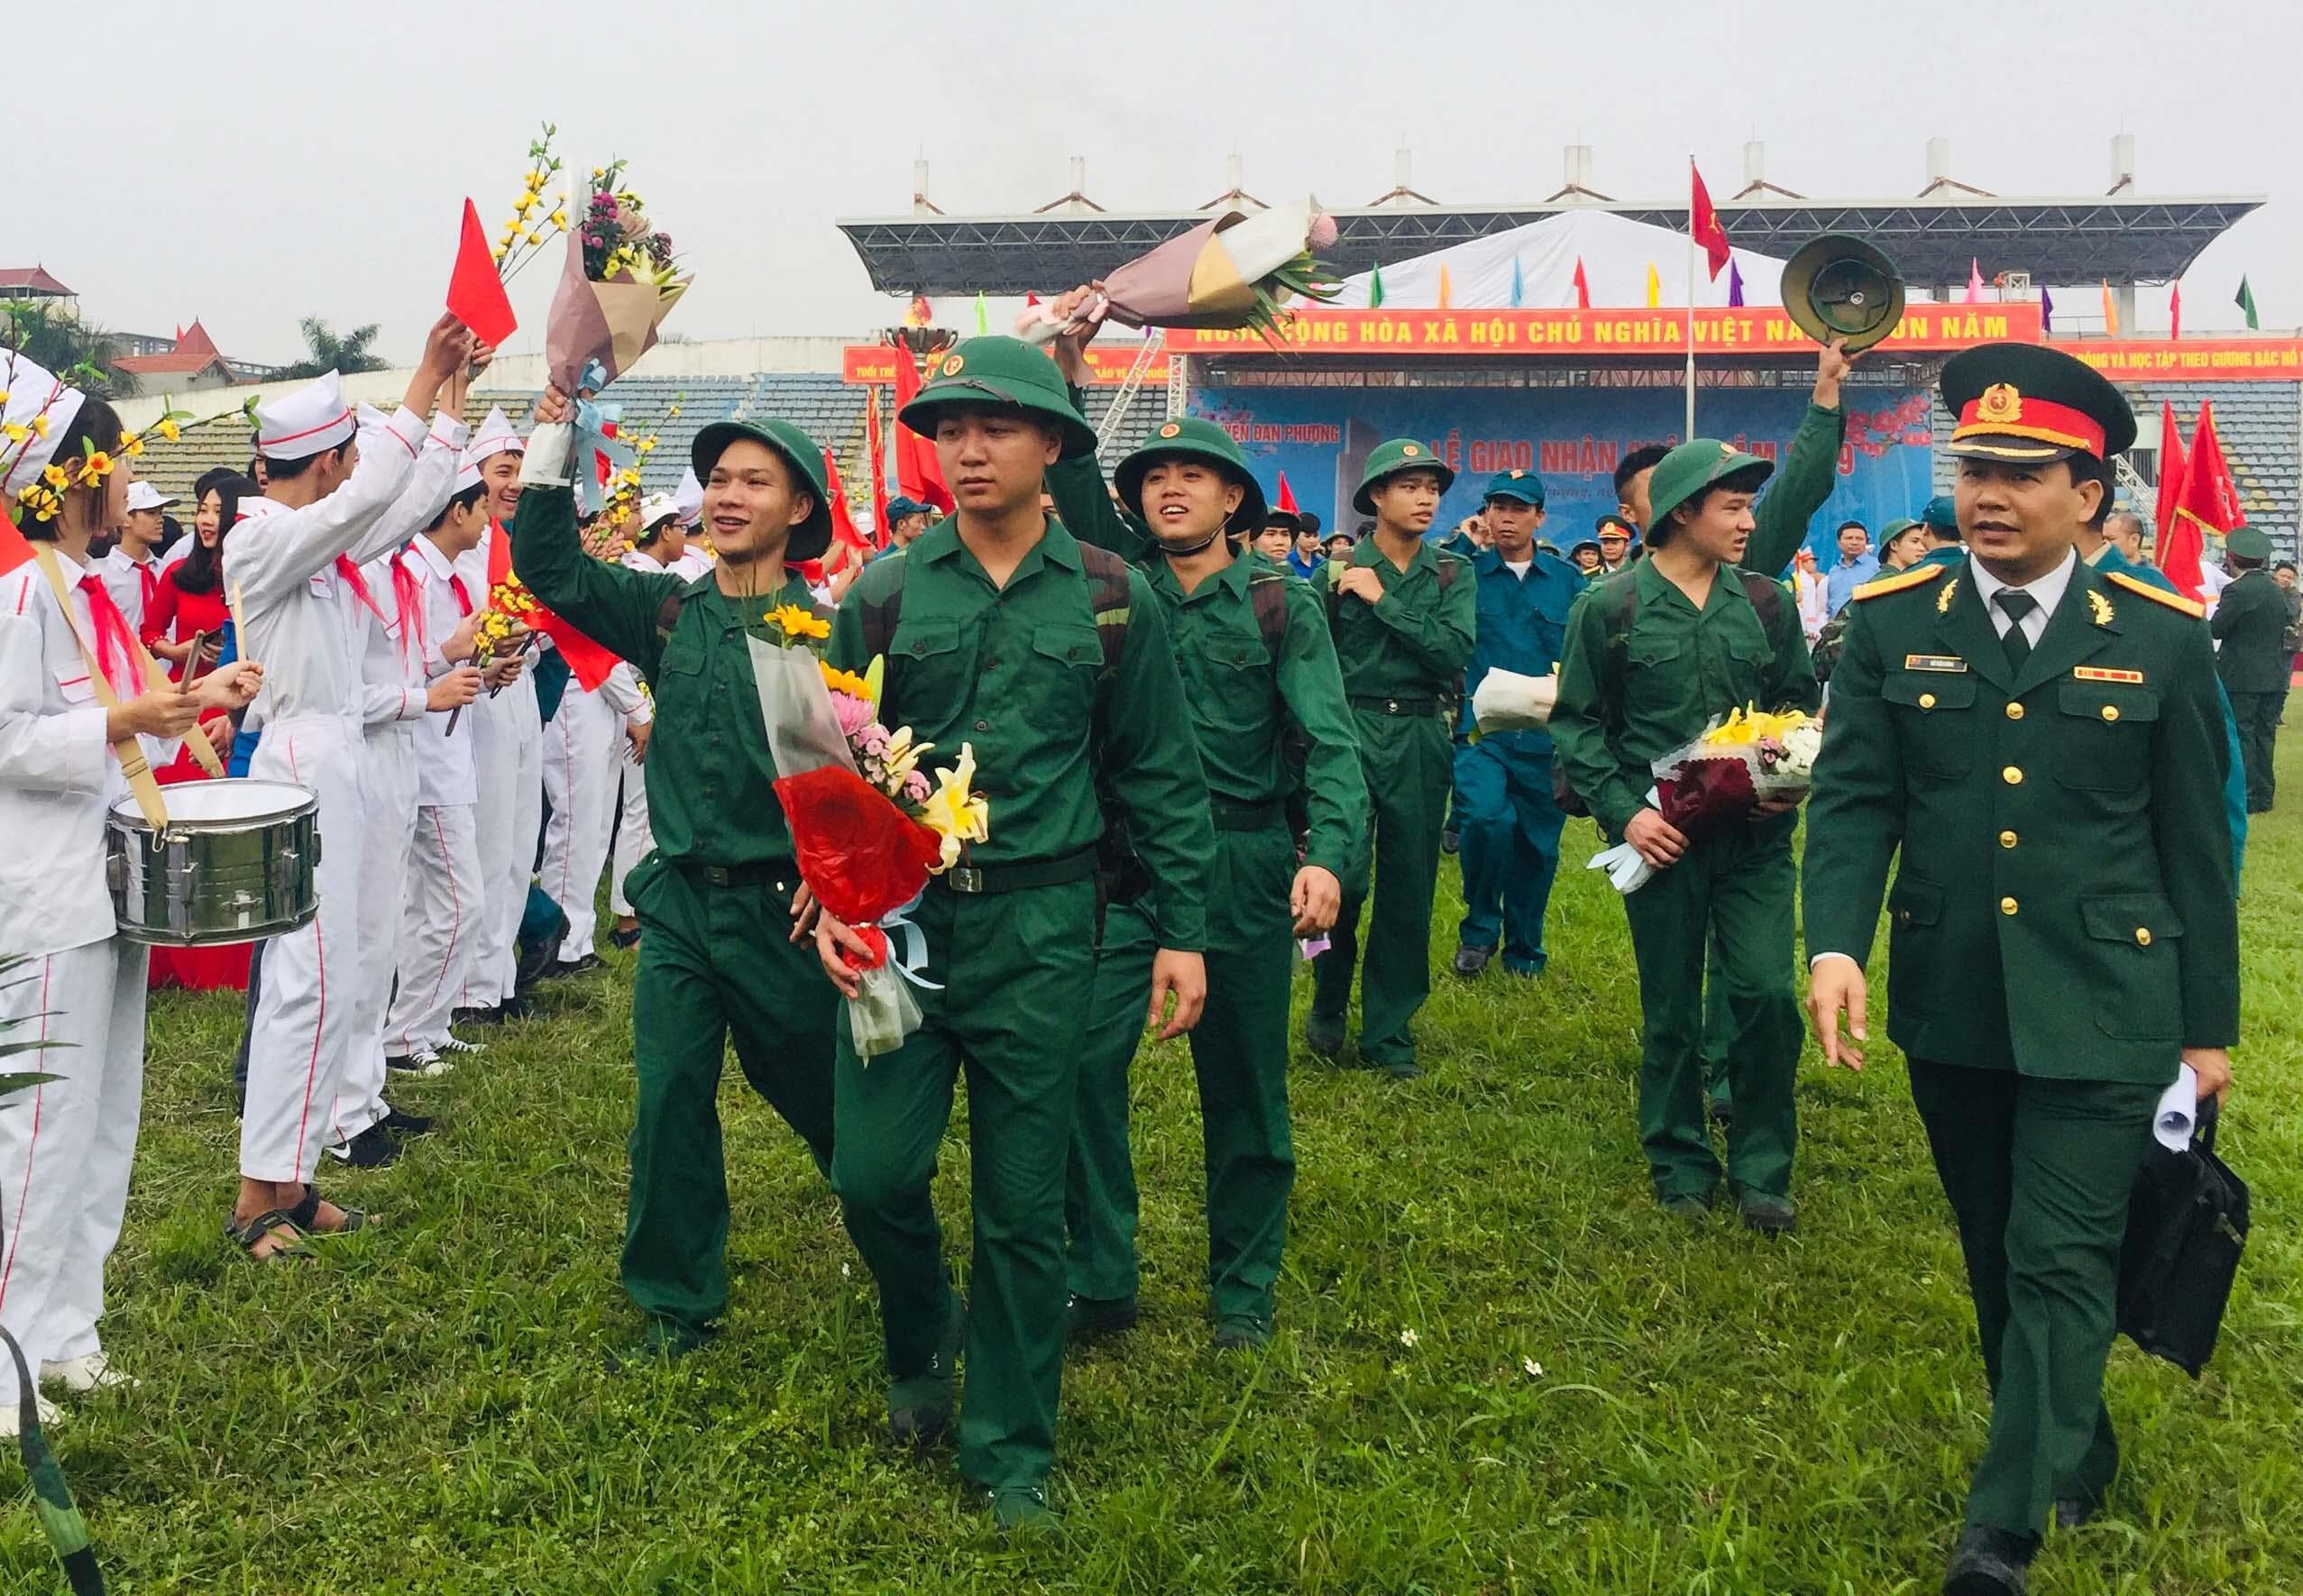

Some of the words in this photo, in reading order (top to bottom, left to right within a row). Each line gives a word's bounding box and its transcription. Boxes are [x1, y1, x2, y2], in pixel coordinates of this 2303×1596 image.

[1360, 316, 1413, 343] HÒA
[1424, 317, 1458, 344] XÃ
[1470, 317, 1516, 347] HỘI
[1528, 314, 1582, 344] CHỦ
[1593, 316, 1681, 344] NGHĨA
[1693, 316, 1754, 346] VIỆT
[1766, 319, 1812, 342] NA
[1941, 312, 2008, 339] NĂM
[2110, 349, 2126, 369] VÀ
[2154, 350, 2177, 371] TẬP
[2179, 352, 2209, 368] THEO
[1469, 440, 1533, 473] GIAO
[1540, 434, 1619, 482] NHẬN
